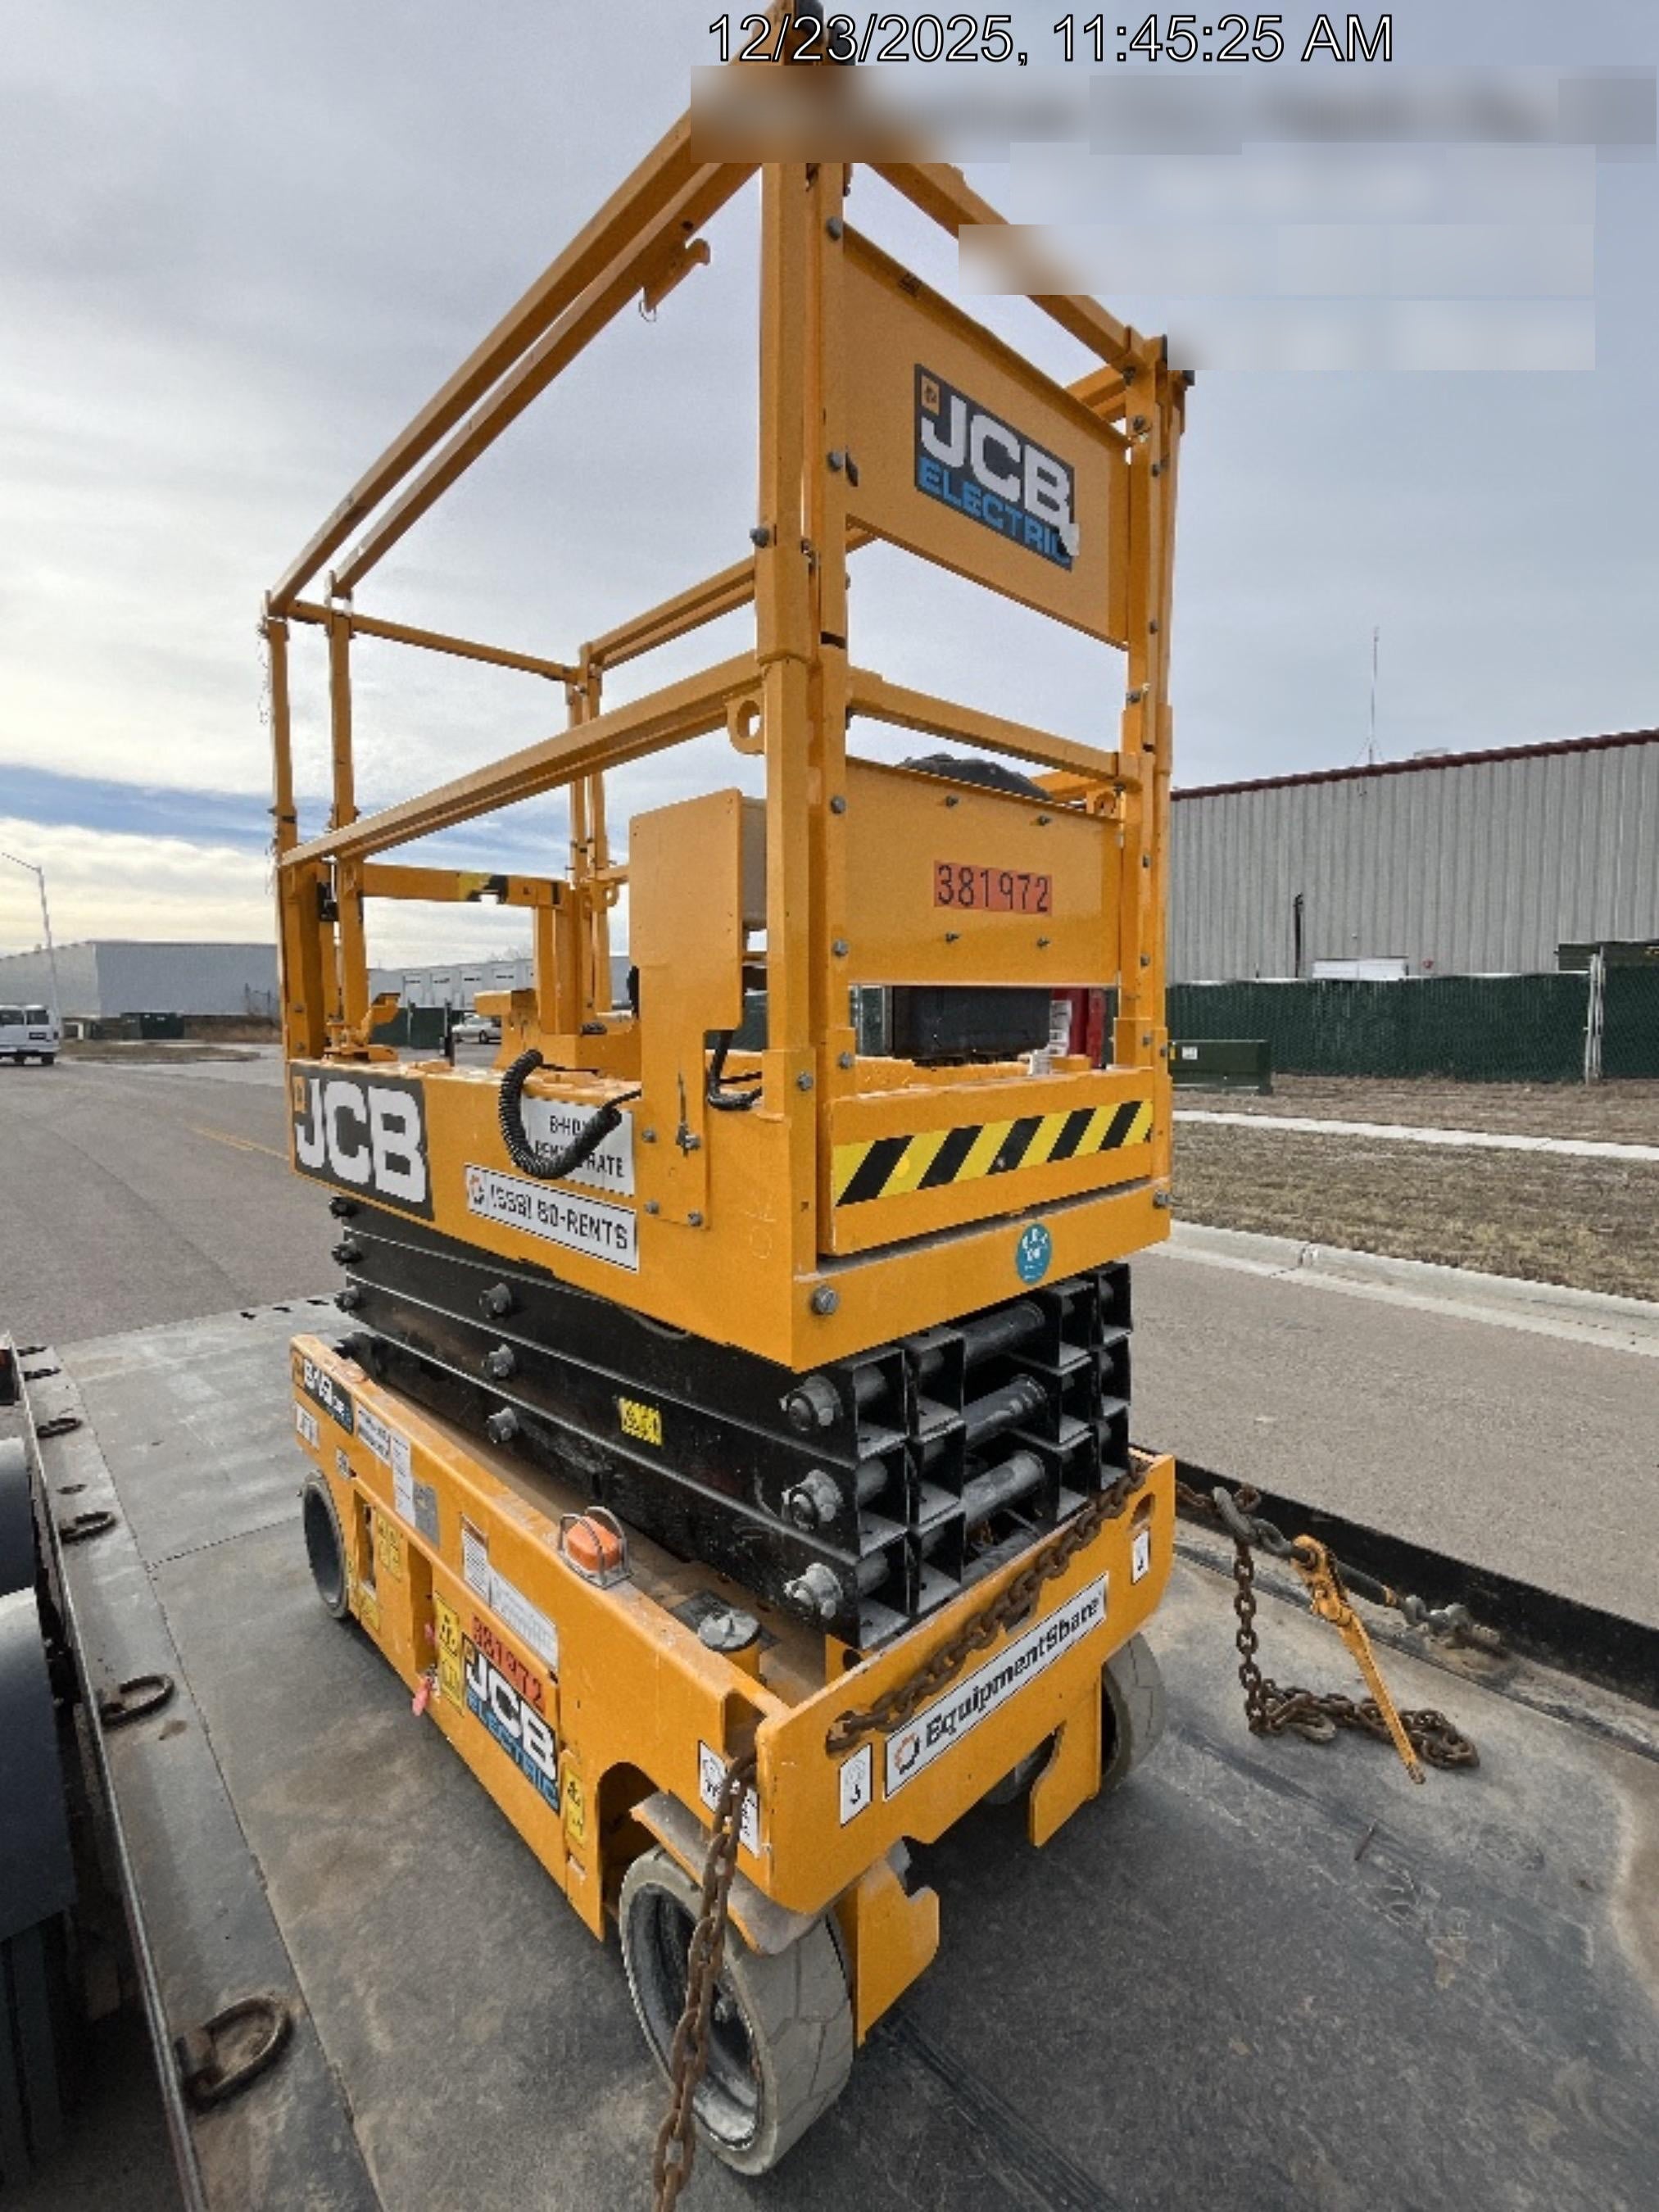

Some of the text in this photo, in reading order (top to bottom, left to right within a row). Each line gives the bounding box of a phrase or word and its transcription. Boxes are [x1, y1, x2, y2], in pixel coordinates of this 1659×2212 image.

[920, 394, 1072, 530] JCB
[937, 863, 1049, 913] 381972
[294, 1077, 428, 1203] JCB
[465, 1652, 558, 1781] JCB
[473, 1616, 543, 1713] 381972
[925, 1597, 1099, 1747] EquipmentShare
